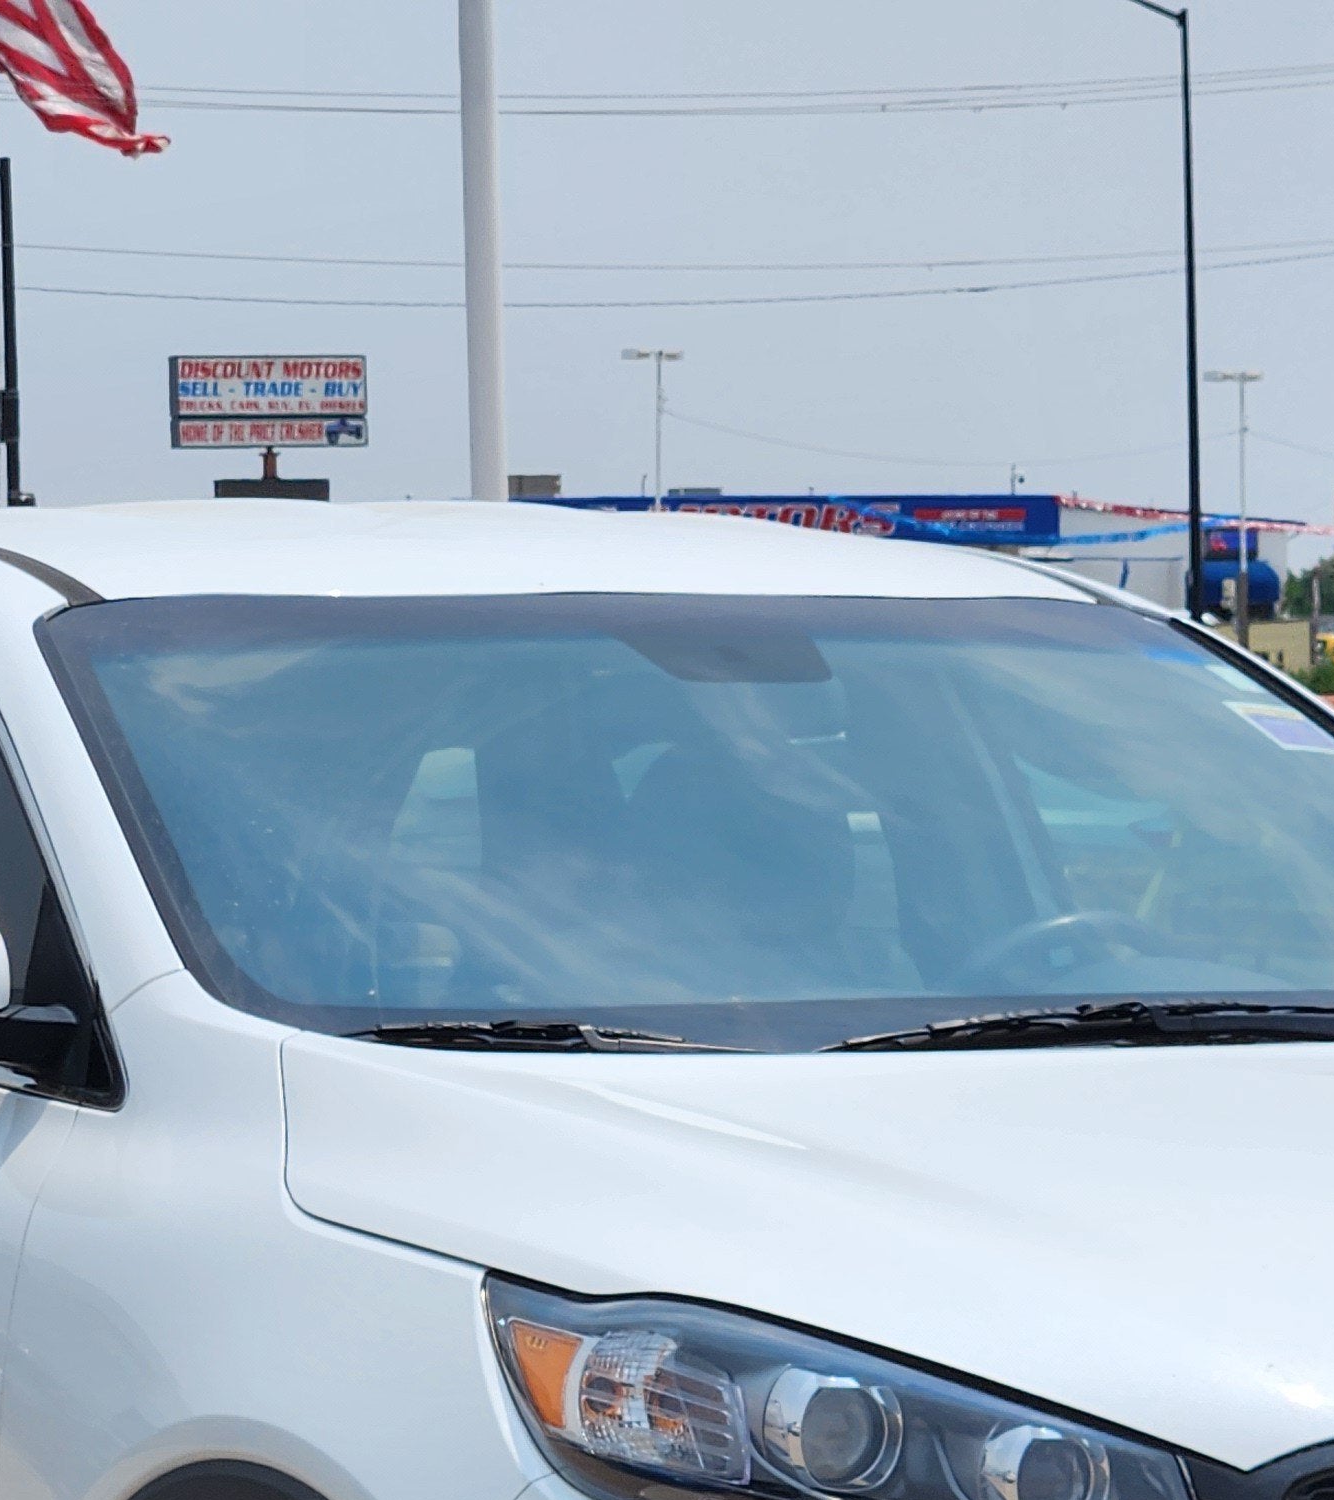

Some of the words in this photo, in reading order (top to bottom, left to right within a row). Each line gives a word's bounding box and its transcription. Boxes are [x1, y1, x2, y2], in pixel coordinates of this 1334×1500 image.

[180, 360, 274, 379] DISCOUNT
[282, 361, 363, 379] MOTORS
[178, 381, 222, 398] SELL
[243, 381, 304, 398] TRADE
[324, 381, 364, 397] BUY
